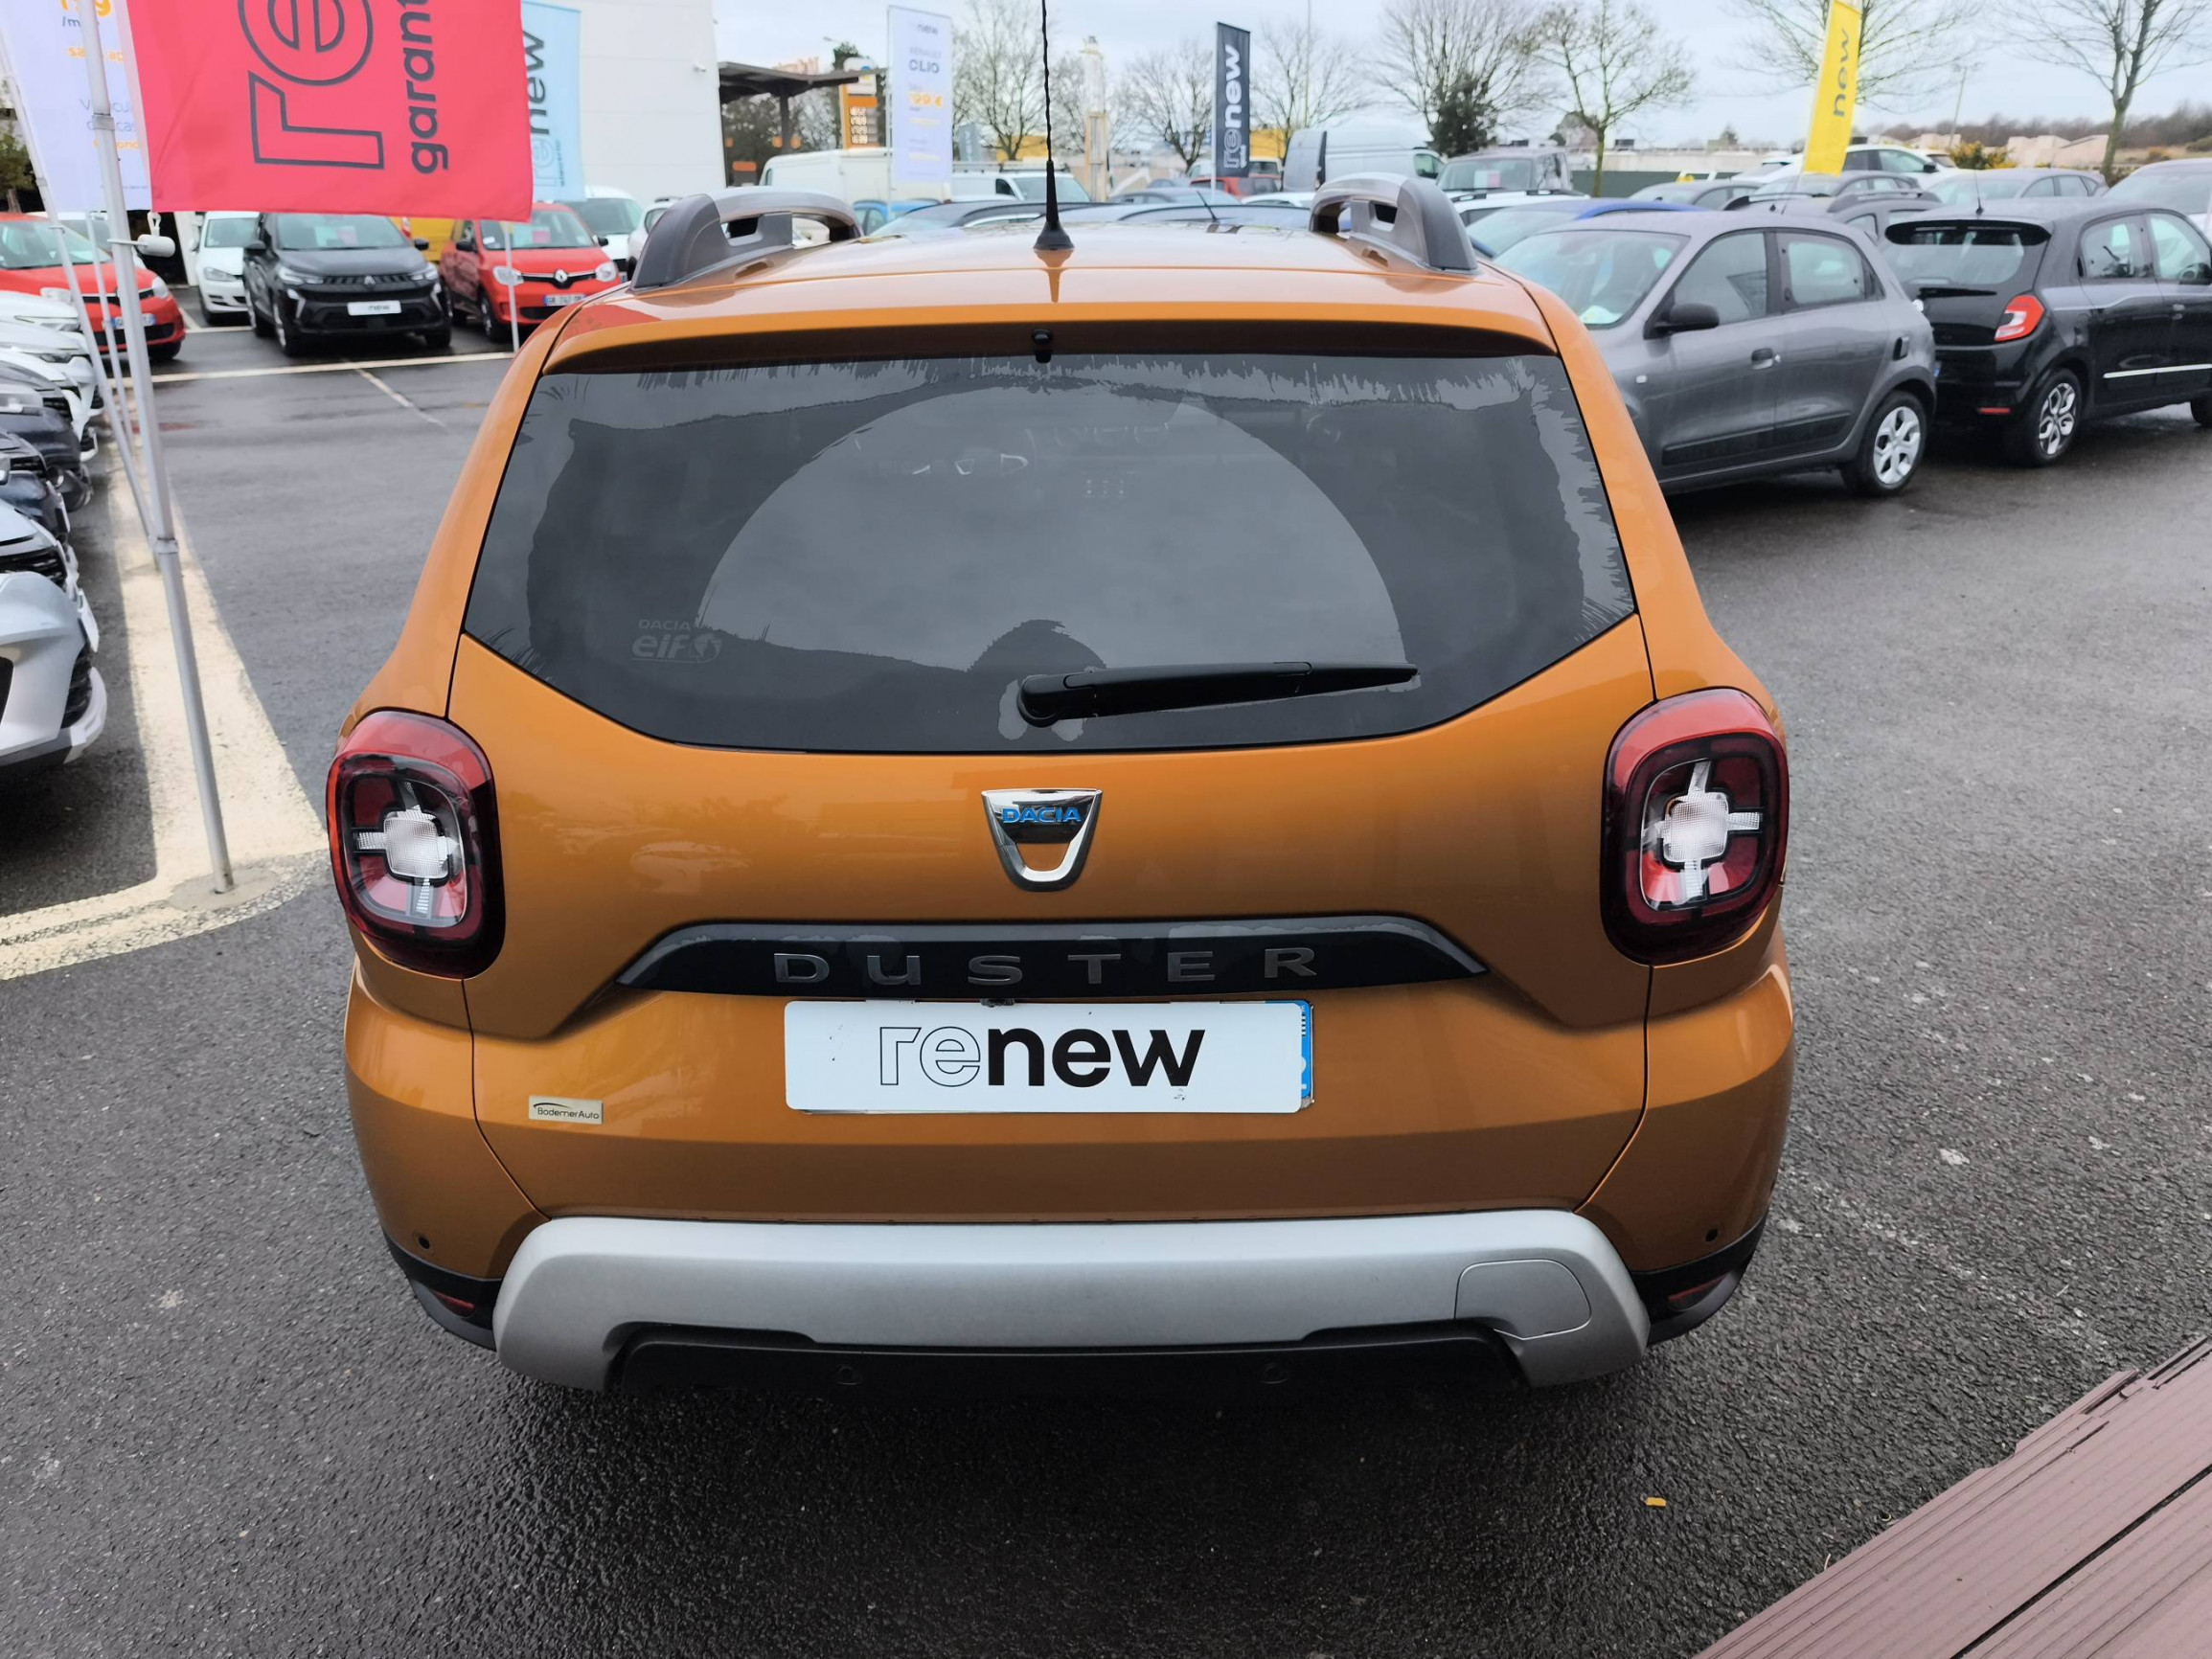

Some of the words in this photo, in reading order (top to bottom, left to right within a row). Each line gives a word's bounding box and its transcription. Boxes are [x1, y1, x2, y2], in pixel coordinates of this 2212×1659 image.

[909, 59, 940, 74] CLIO
[1223, 44, 1242, 168] renew
[638, 619, 691, 631] DACIA
[1002, 807, 1082, 824] DACIA
[773, 946, 1317, 985] DUSTER
[878, 1025, 1206, 1088] renew
